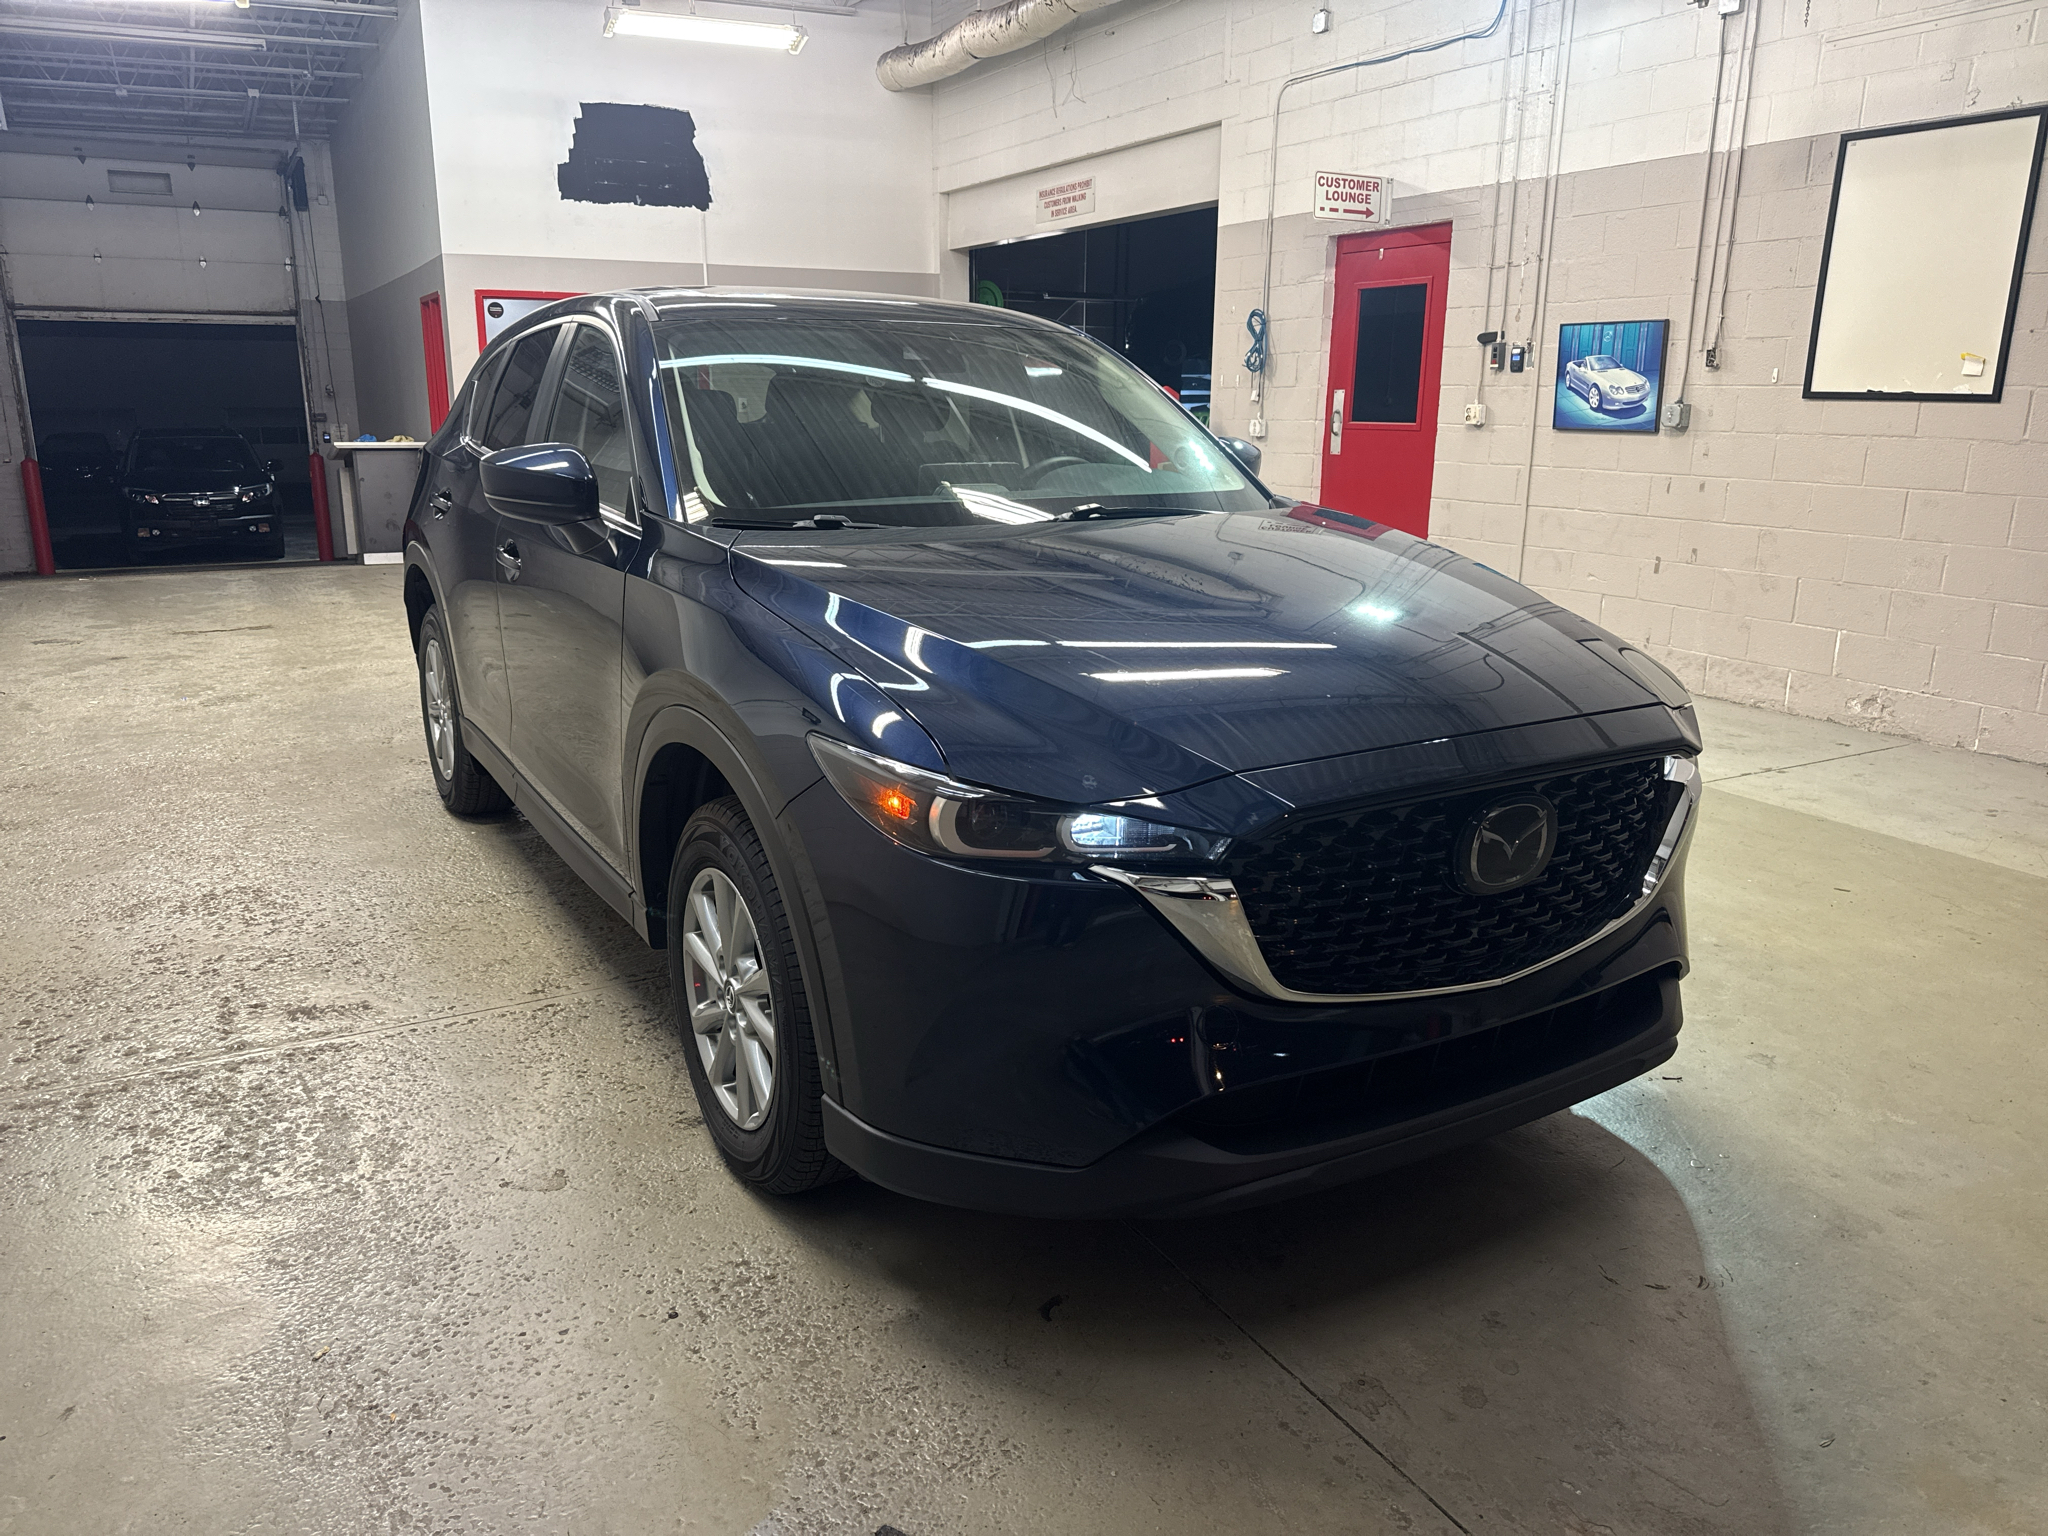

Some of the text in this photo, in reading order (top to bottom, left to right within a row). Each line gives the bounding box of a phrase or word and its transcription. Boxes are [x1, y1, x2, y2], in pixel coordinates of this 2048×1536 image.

[1039, 179, 1093, 199] INSURANCE REGULATIONS PROHIBIT
[1318, 176, 1379, 192] CUSTOMER
[1044, 193, 1086, 209] CUSTOMERS FROM WALKING
[1326, 190, 1371, 204] LOUNGE
[1055, 206, 1067, 217] SERVICE
[719, 834, 784, 1004] YOKOHAMA
